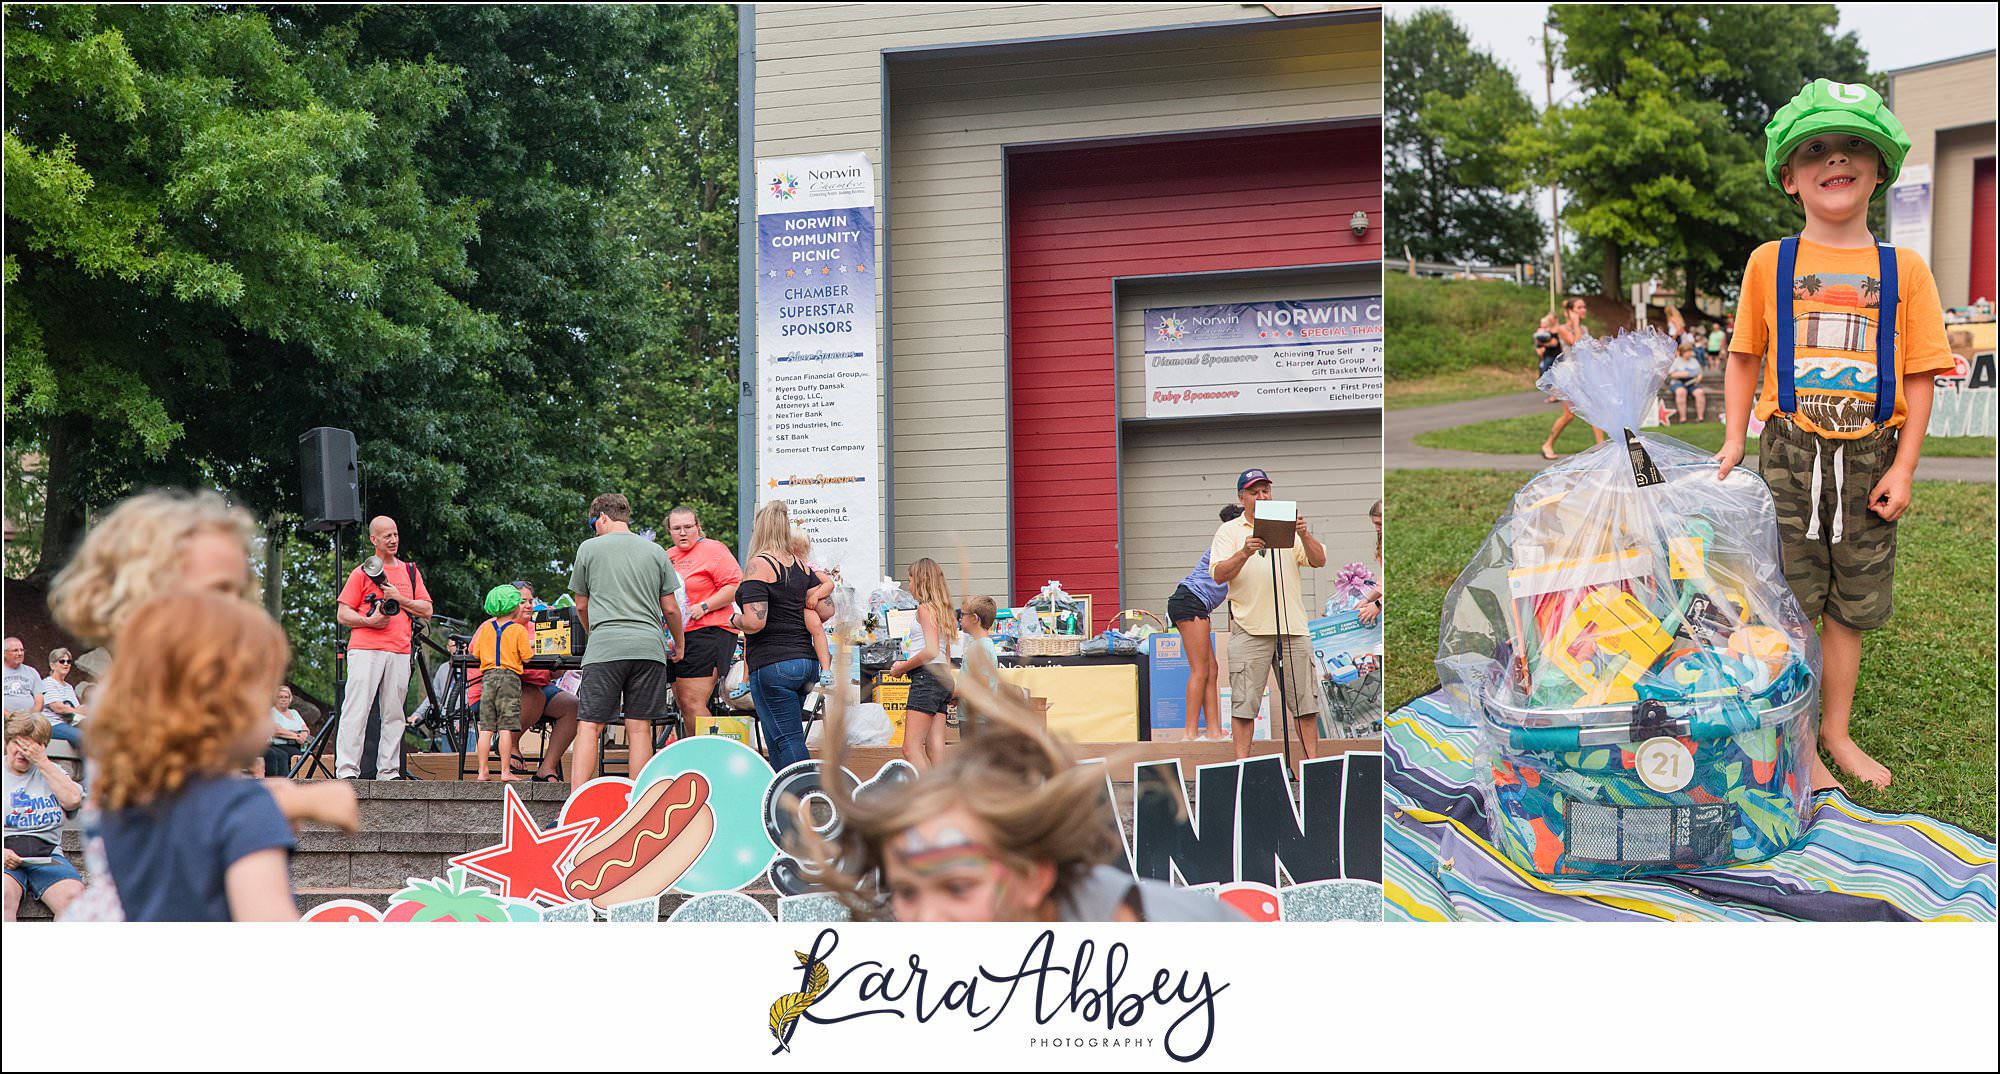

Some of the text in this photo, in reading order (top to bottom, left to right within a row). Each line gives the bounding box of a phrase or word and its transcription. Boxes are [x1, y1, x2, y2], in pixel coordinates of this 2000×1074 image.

[1838, 84, 1859, 99] L
[809, 165, 861, 180] Norwin
[785, 215, 847, 231] NORWIN
[772, 230, 860, 248] COMMUNITY
[792, 248, 841, 263] PICNIC
[784, 285, 849, 300] CHAMBER
[779, 303, 855, 319] SUPERSTAR
[1257, 305, 1357, 328] NORWIN
[1192, 313, 1239, 326] Norwin
[782, 320, 852, 337] SPONSORS
[1301, 327, 1348, 338] SPECIAL
[1273, 349, 1314, 359] Achieving
[1337, 347, 1353, 355] Self
[1286, 360, 1314, 368] Harper
[1339, 358, 1365, 366] Group
[803, 372, 836, 380] Financial
[1311, 368, 1327, 376] Gift
[1329, 367, 1358, 375] Basket
[797, 384, 818, 392] Duffy
[819, 382, 845, 390] Dansak
[1257, 386, 1291, 395] Comfort
[1293, 385, 1327, 394] Keepers
[775, 402, 810, 410] Attorneys
[831, 444, 865, 453] Company
[792, 506, 840, 516] Bookkeeping
[810, 536, 849, 544] Associates
[1651, 751, 1679, 778] 21
[6, 810, 62, 828] Walkers
